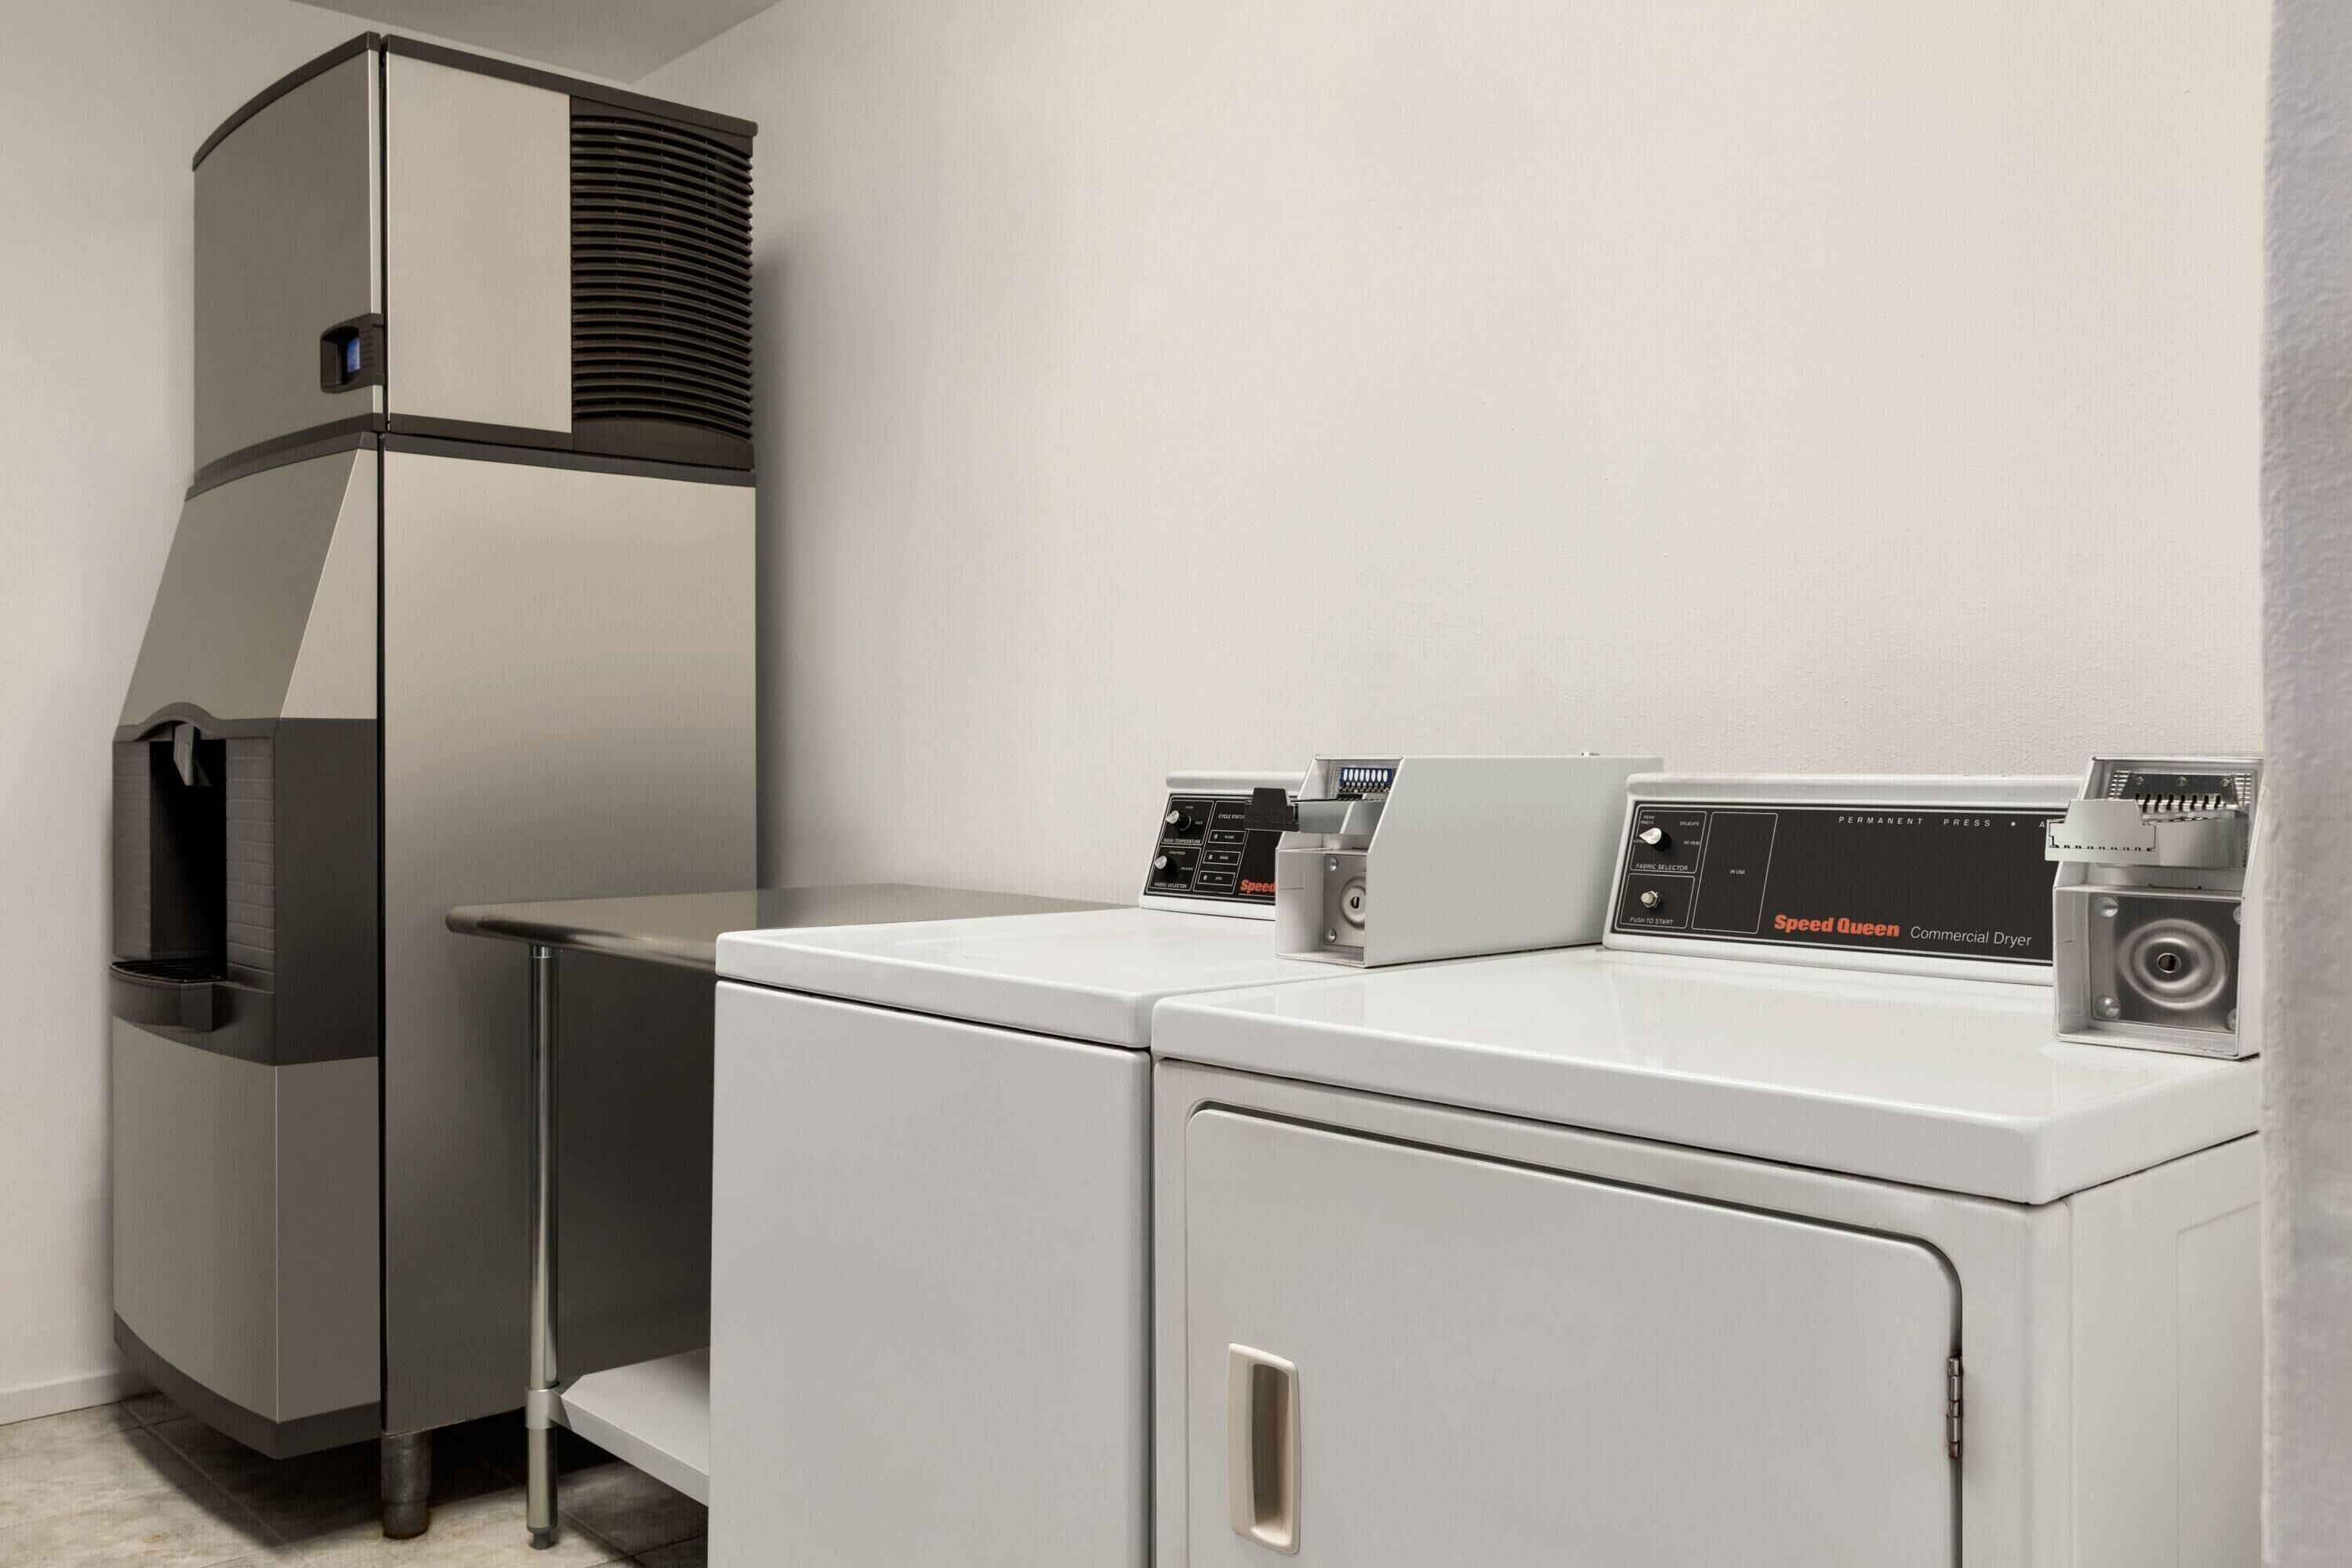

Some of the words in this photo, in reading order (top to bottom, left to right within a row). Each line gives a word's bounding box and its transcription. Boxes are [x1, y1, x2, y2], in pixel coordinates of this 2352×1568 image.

[1838, 816, 1923, 825] PERMANENT
[1774, 914, 1835, 934] Speed
[1836, 917, 1900, 938] Queen
[1910, 926, 1990, 943] Commercial
[1993, 931, 2033, 949] Dryer
